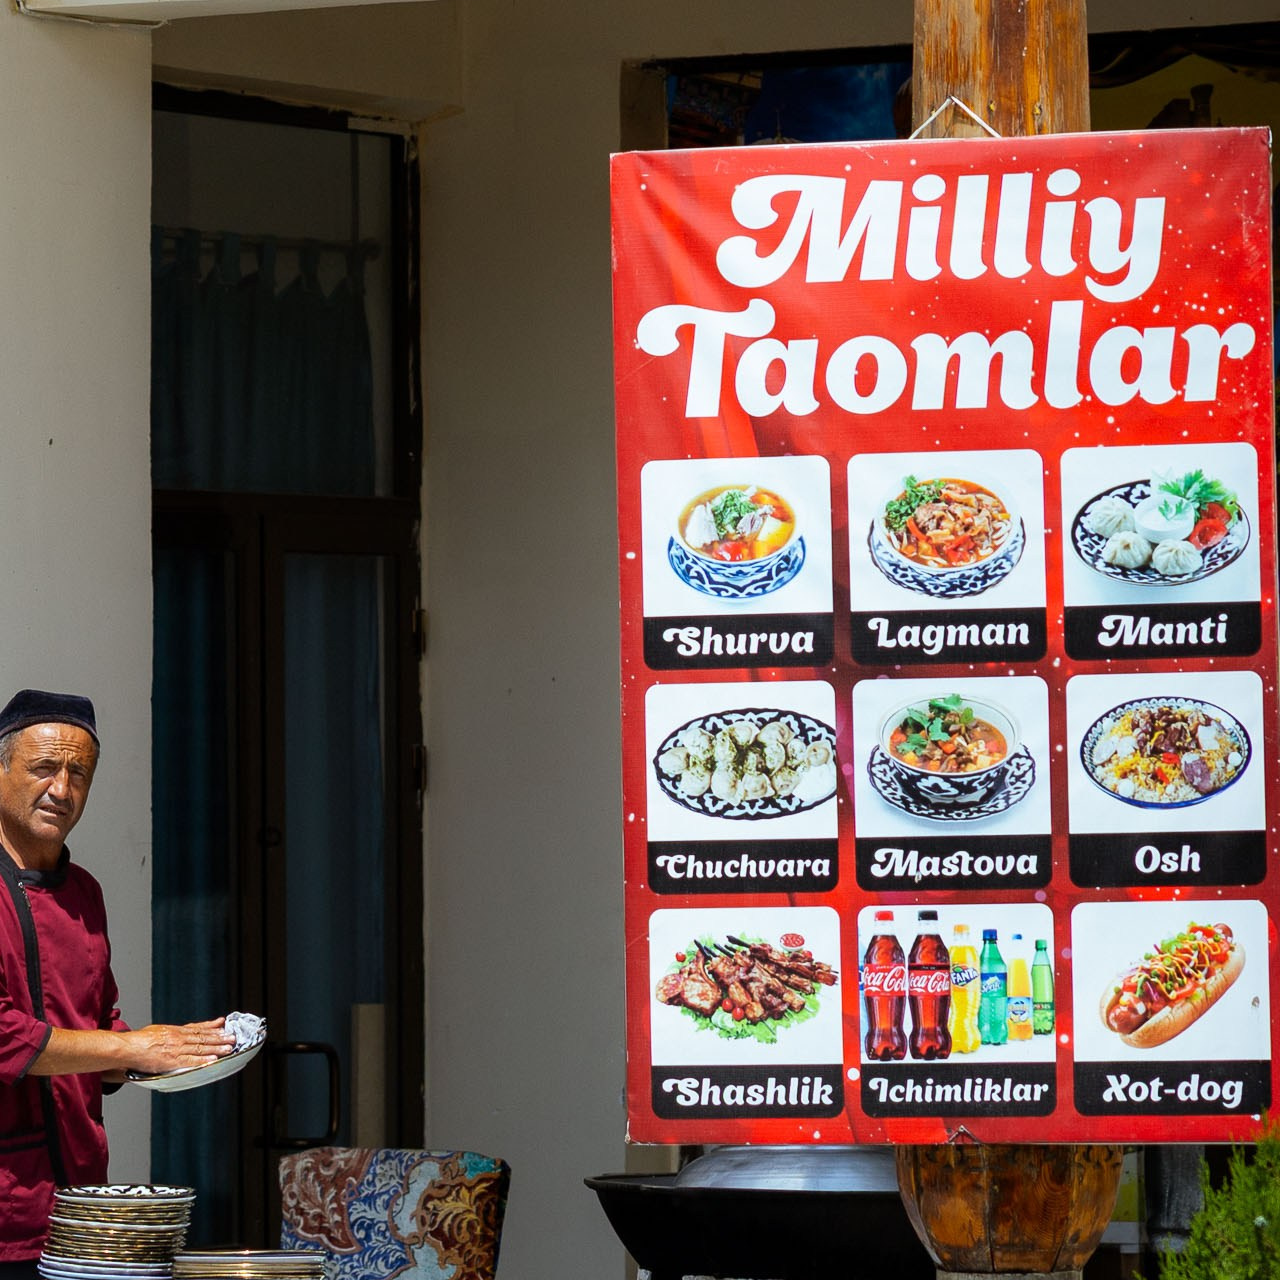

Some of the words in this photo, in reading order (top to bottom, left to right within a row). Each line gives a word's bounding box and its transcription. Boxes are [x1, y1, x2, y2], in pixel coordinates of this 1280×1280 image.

[716, 169, 1166, 303] Milliy
[635, 298, 1256, 418] Taomlar
[663, 626, 814, 658] Shurva
[867, 617, 1030, 656] Lagman
[1097, 613, 1228, 648] Manti
[655, 853, 830, 880] Chuchvara
[870, 848, 1038, 877] Mastova
[1135, 844, 1201, 874] Osh
[662, 1076, 833, 1107] Shashlik
[868, 1077, 1049, 1103] Ichimliklar
[1102, 1073, 1243, 1109] Xot-dog
